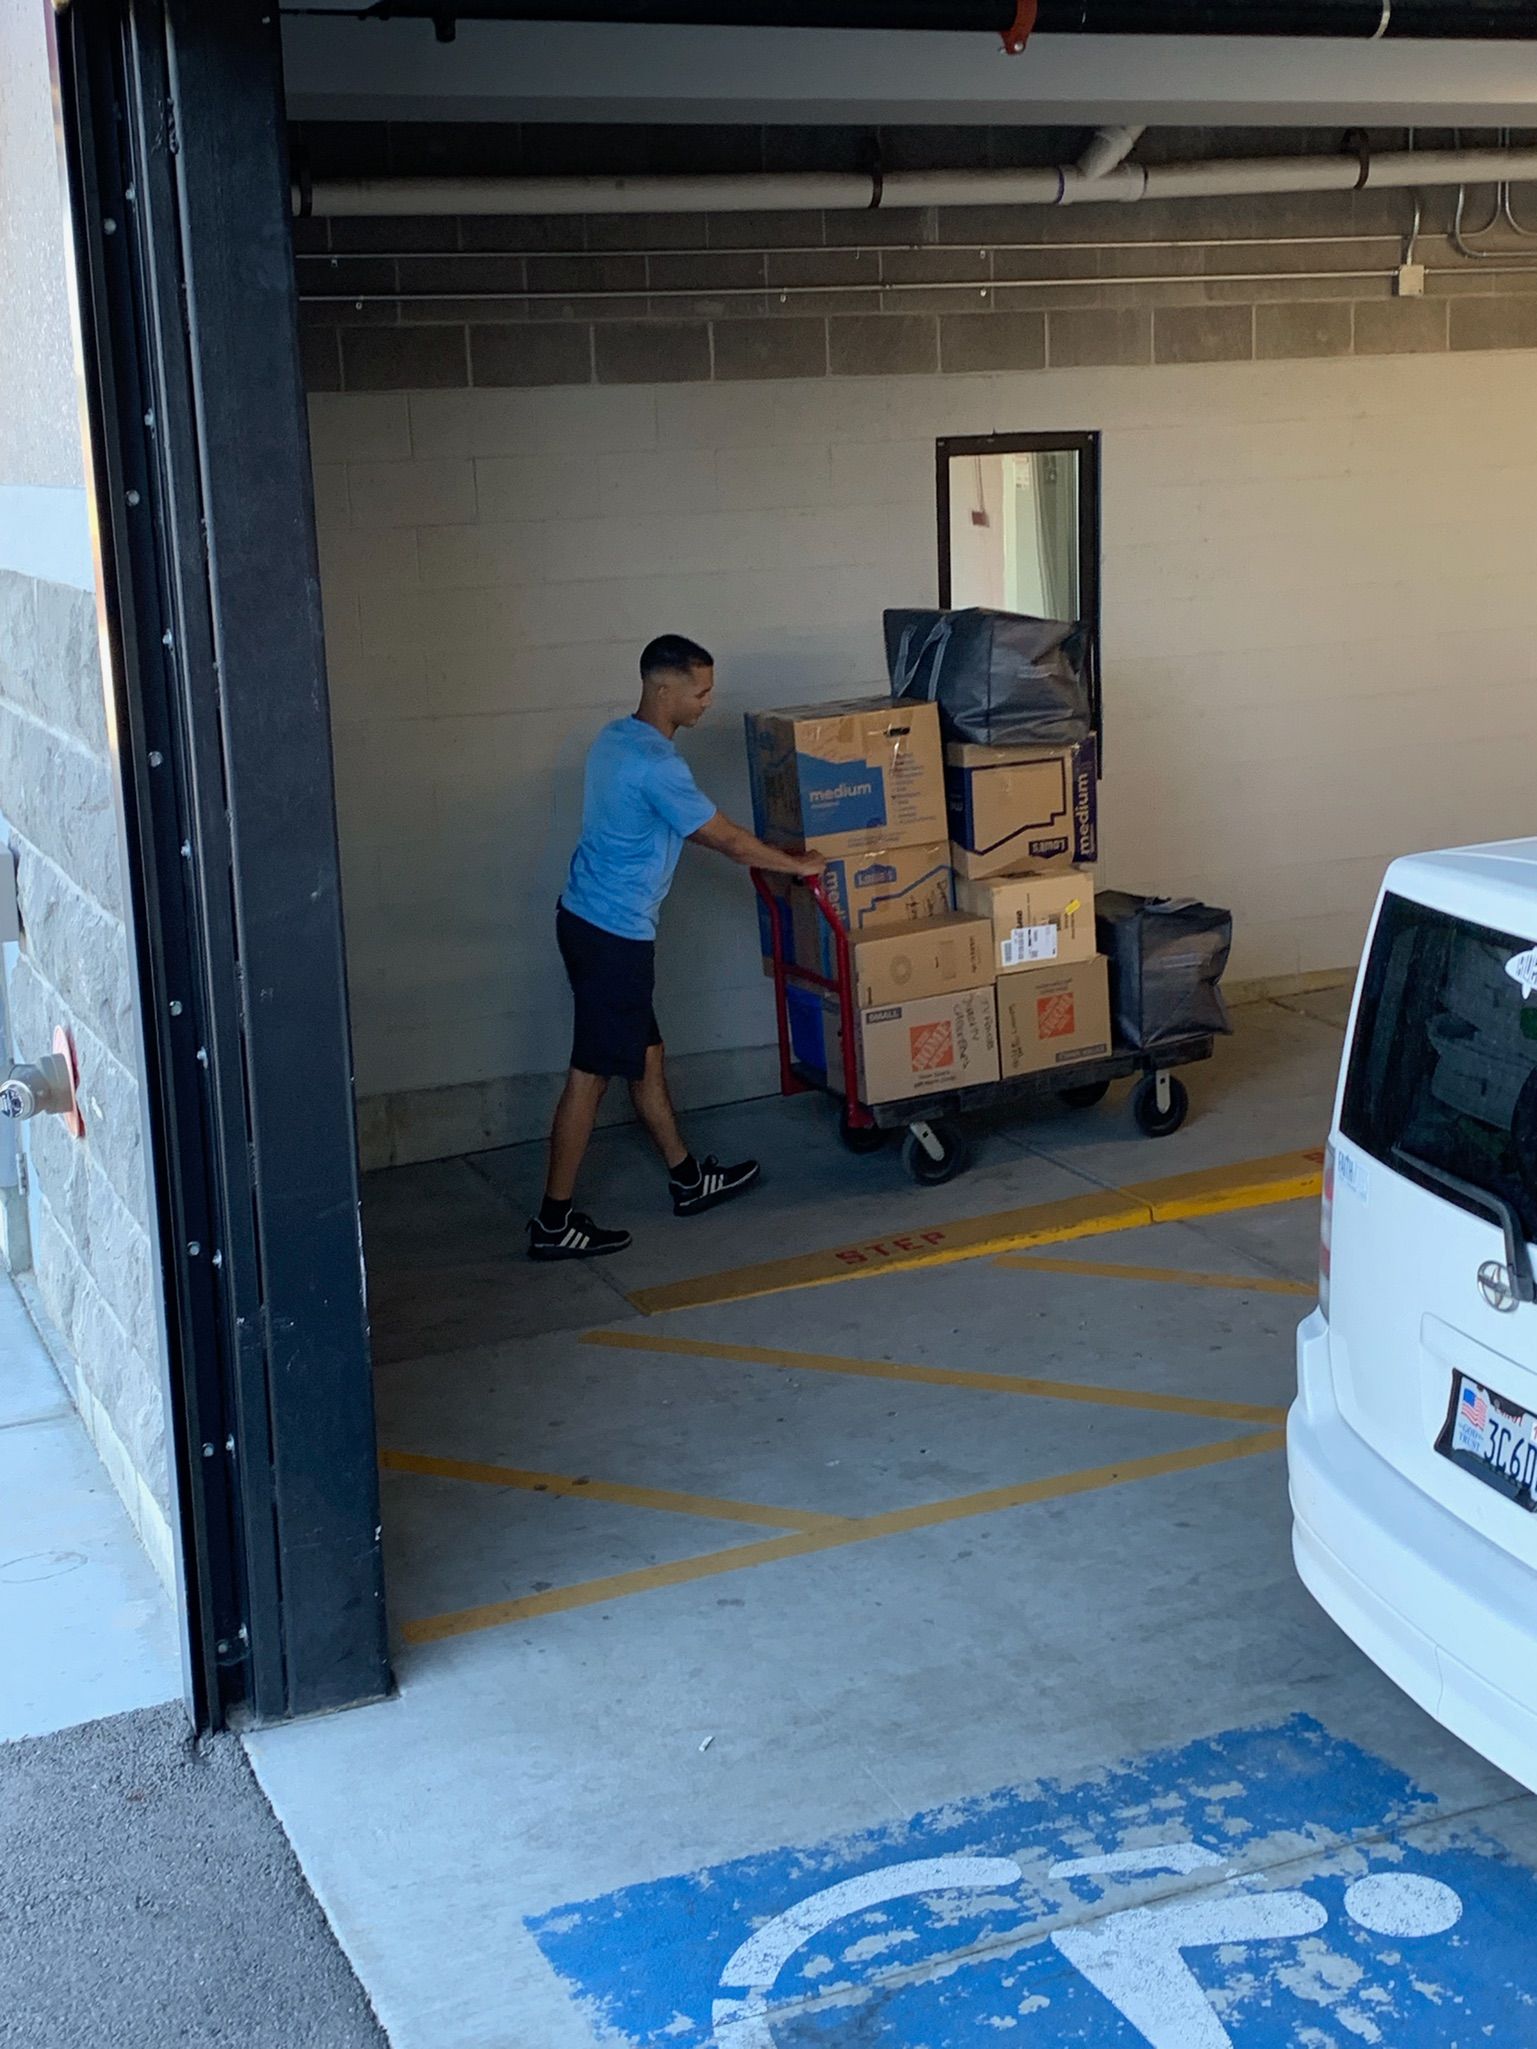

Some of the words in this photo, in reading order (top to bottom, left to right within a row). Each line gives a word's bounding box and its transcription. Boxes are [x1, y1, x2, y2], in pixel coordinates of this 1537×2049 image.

[809, 783, 872, 802] medium
[1074, 772, 1089, 855] medium
[835, 1231, 945, 1265] STEP
